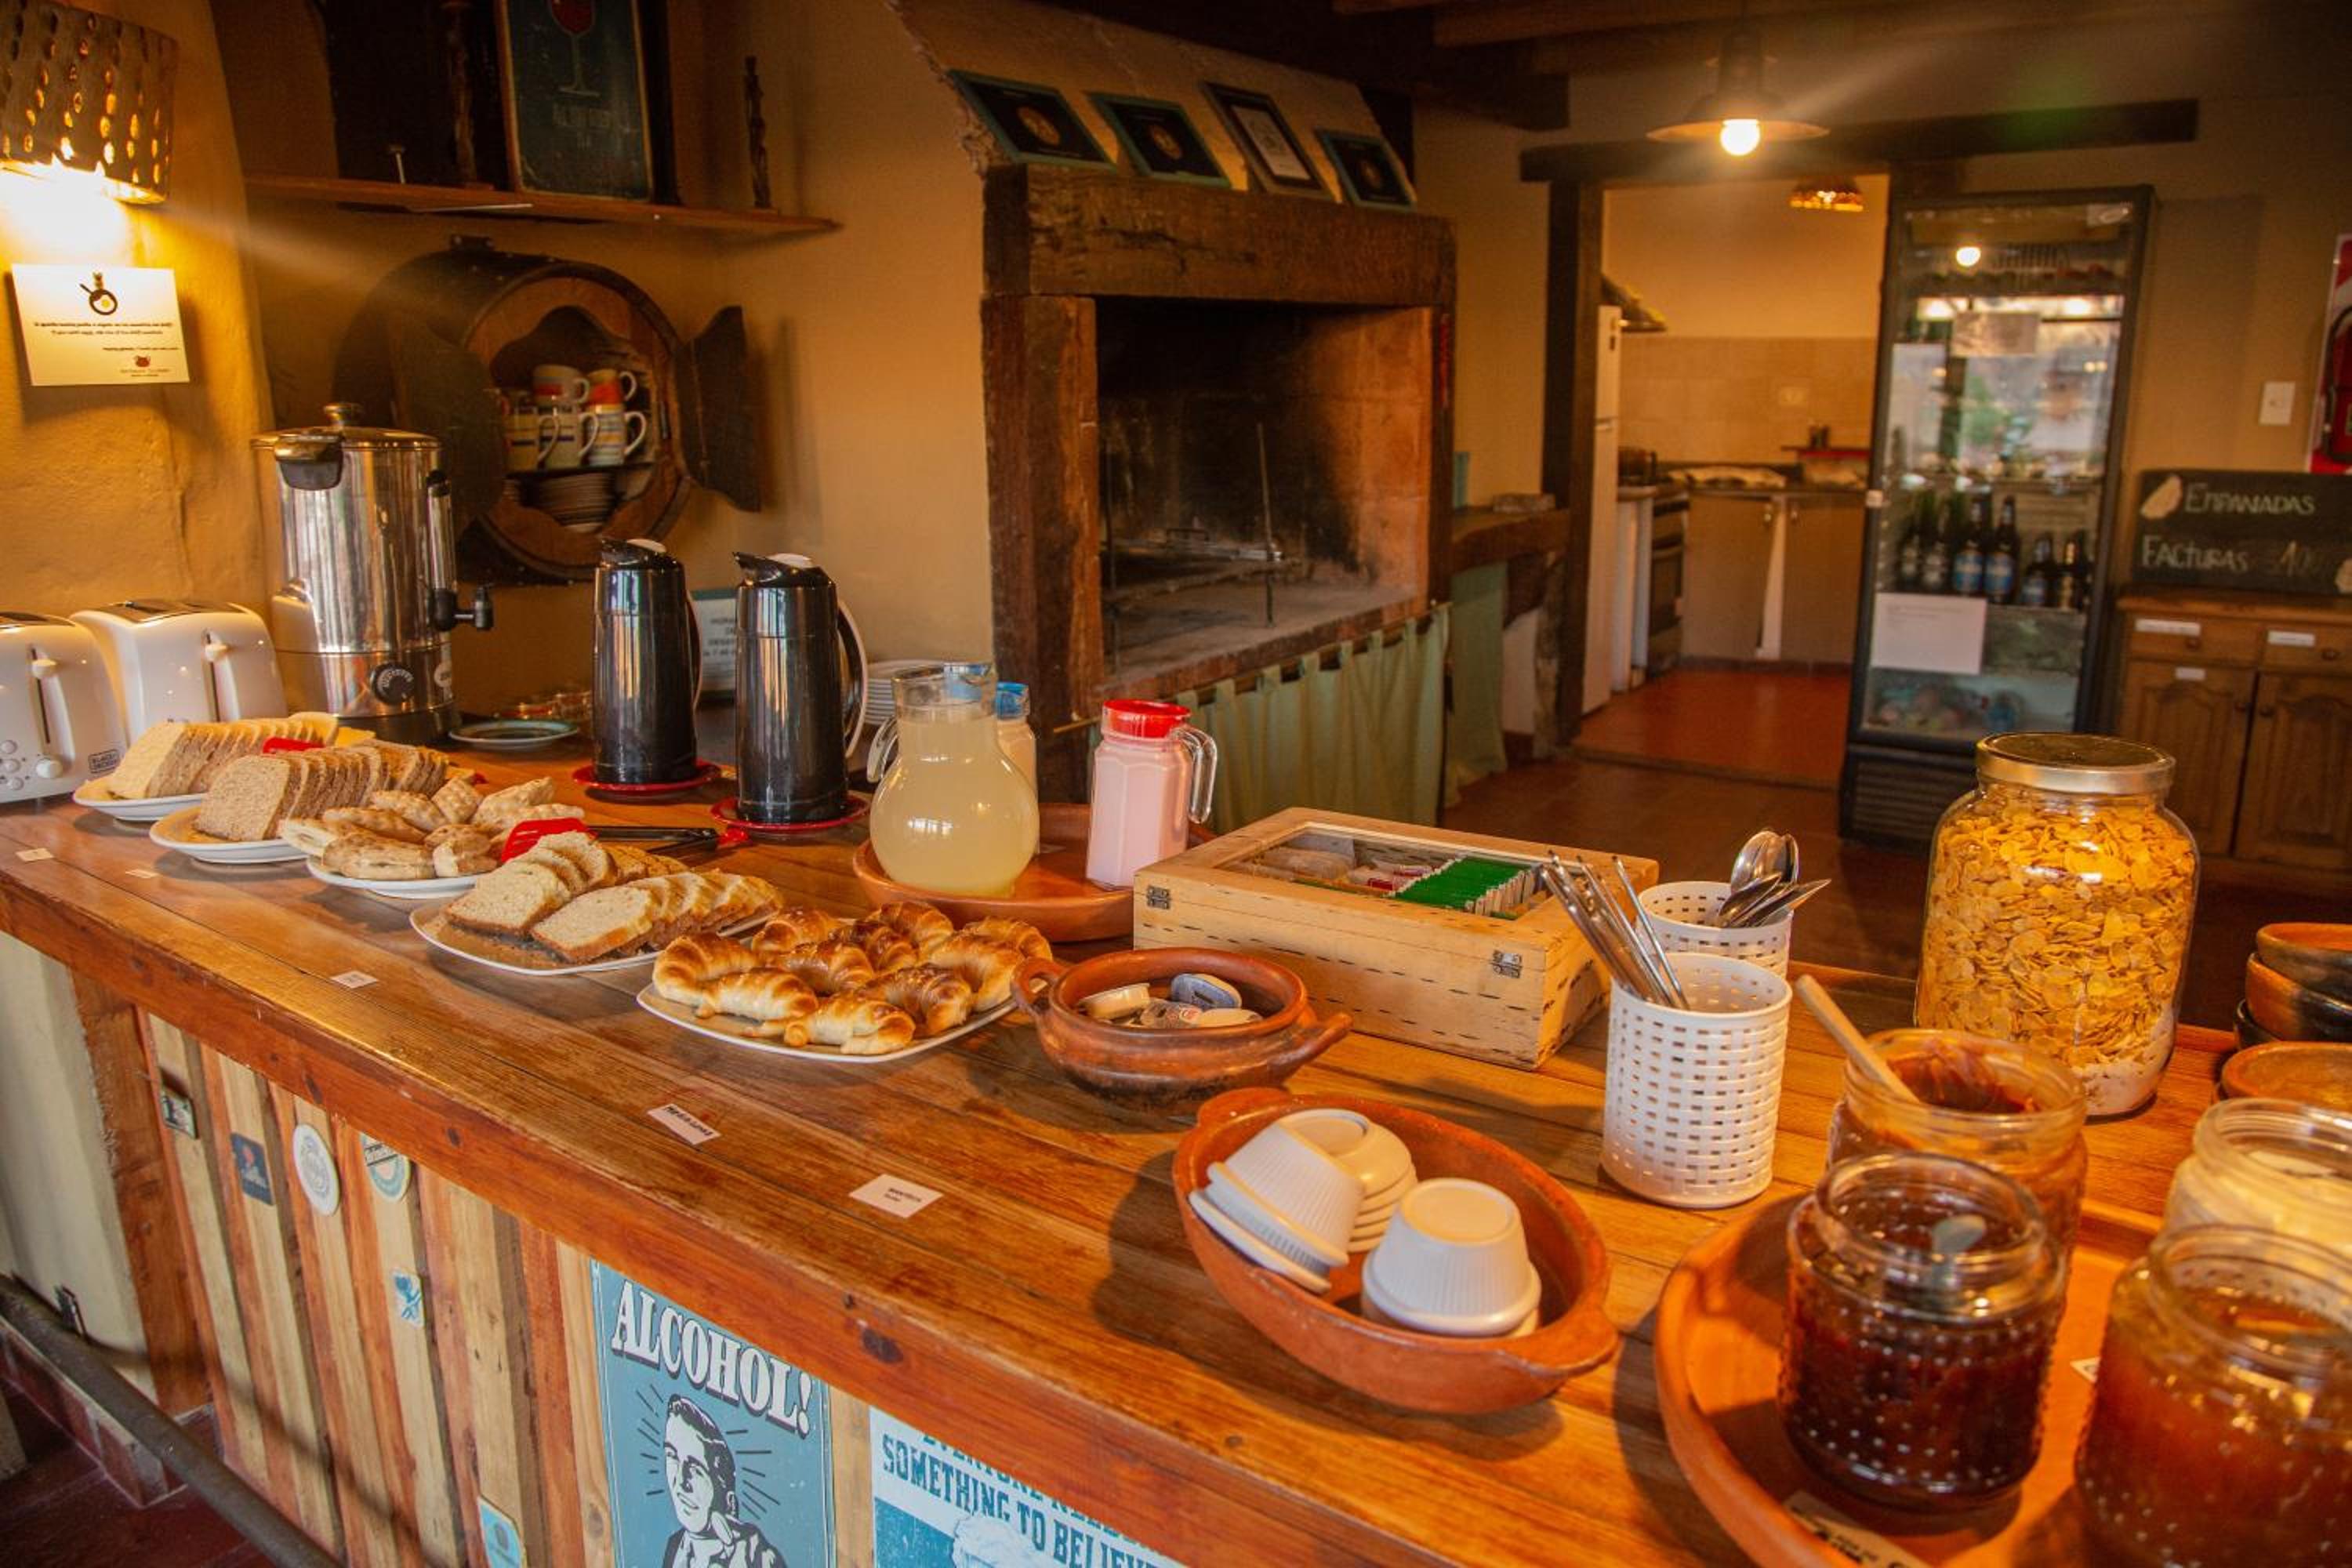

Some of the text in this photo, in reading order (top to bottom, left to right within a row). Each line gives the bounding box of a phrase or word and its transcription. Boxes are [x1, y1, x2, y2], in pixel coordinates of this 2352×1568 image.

[612, 1280, 812, 1439] ALCOHOL!
[882, 1433, 1011, 1522] SOMETHING
[1017, 1501, 1046, 1552] TO
[1054, 1519, 1160, 1568] BELIE
